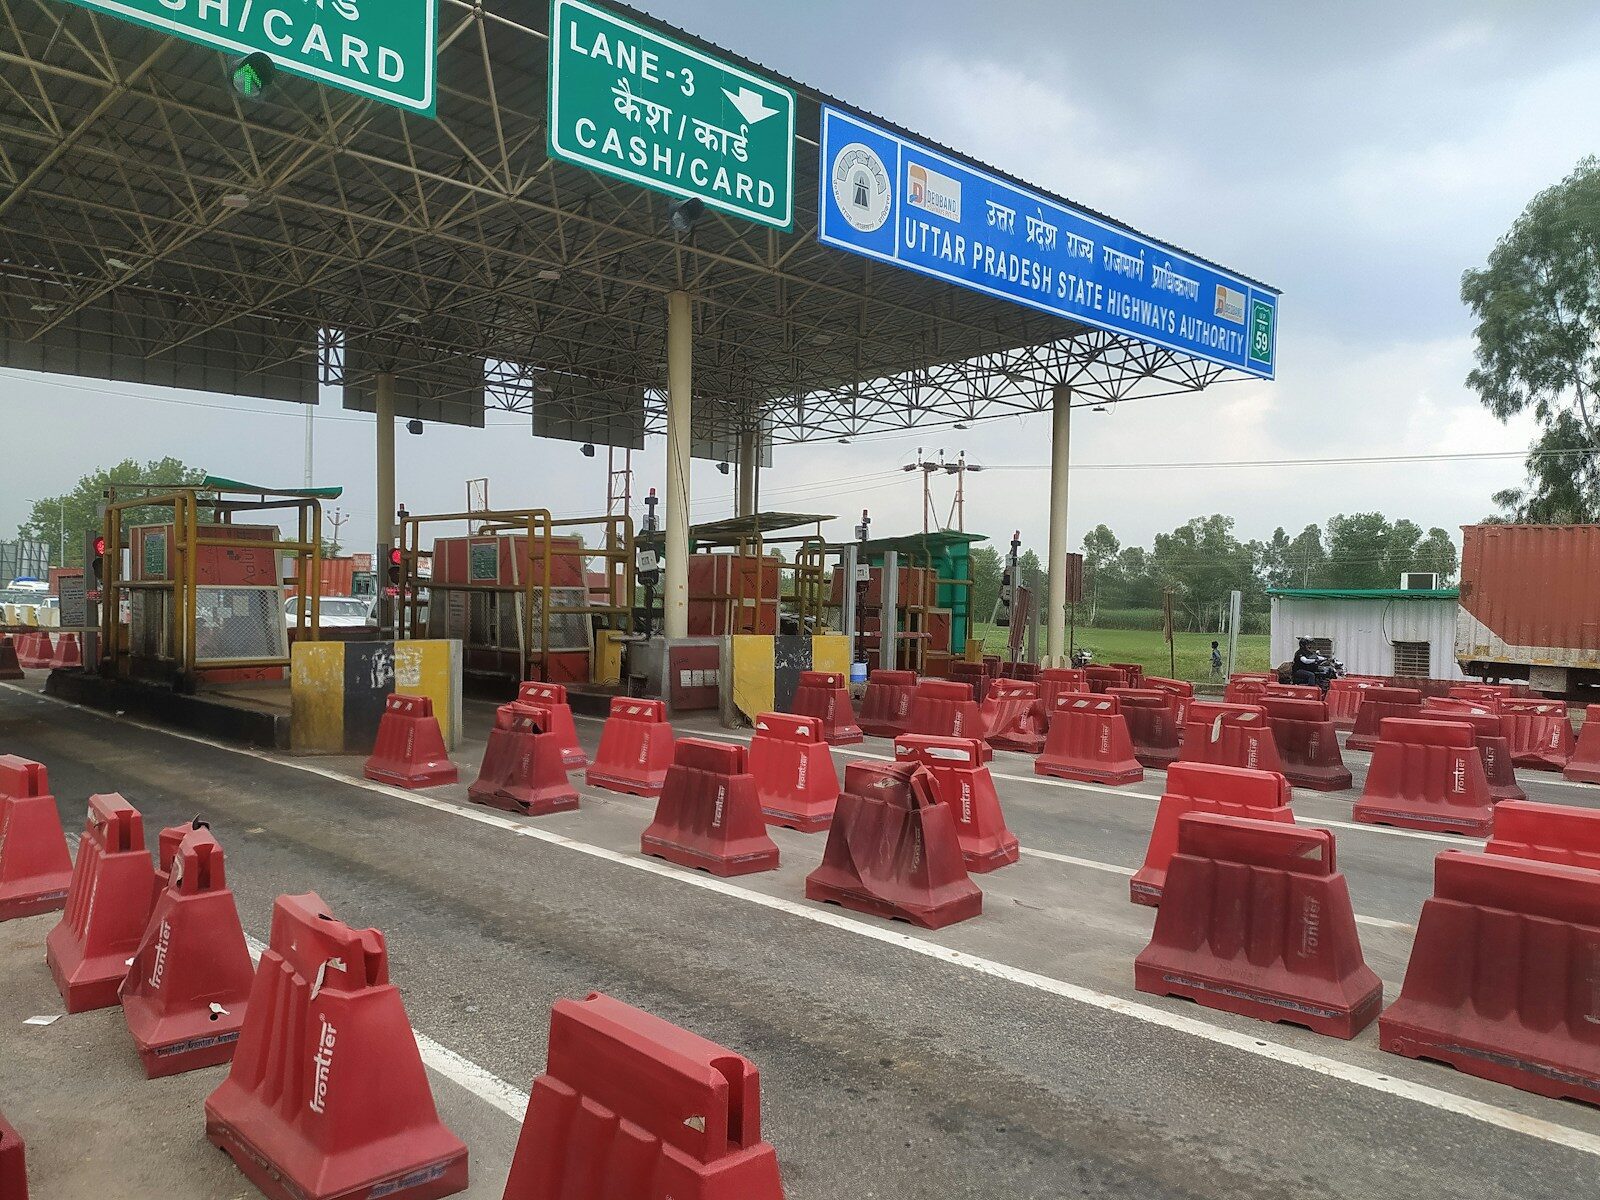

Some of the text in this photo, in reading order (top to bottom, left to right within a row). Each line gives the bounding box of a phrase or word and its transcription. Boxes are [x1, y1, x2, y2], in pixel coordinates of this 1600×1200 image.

[575, 118, 775, 208] CASH/CARD
[927, 189, 957, 213] DEOBAND
[986, 199, 1017, 235] उत्तर
[1026, 207, 1058, 251] प्रदेश
[1066, 231, 1095, 264] राज्य
[1103, 249, 1145, 282] राजमार्ग
[1151, 261, 1200, 302] प्राधिकरण
[905, 216, 966, 266] UTTAR
[972, 241, 1053, 294] PRADESH
[1057, 271, 1103, 310] STATE
[1106, 289, 1176, 335] HIGHWAYS
[1178, 314, 1245, 356] AUTHORITY
[1255, 330, 1268, 352] 59
[1099, 724, 1110, 754] frontier
[1246, 736, 1258, 769] frontier
[1549, 725, 1561, 748] frontier
[796, 752, 808, 790] frontier
[1452, 758, 1465, 793] frontier
[711, 783, 725, 828] frontier
[960, 779, 971, 824] frontier
[149, 917, 172, 990] frontier
[310, 1020, 338, 1115] frontier
